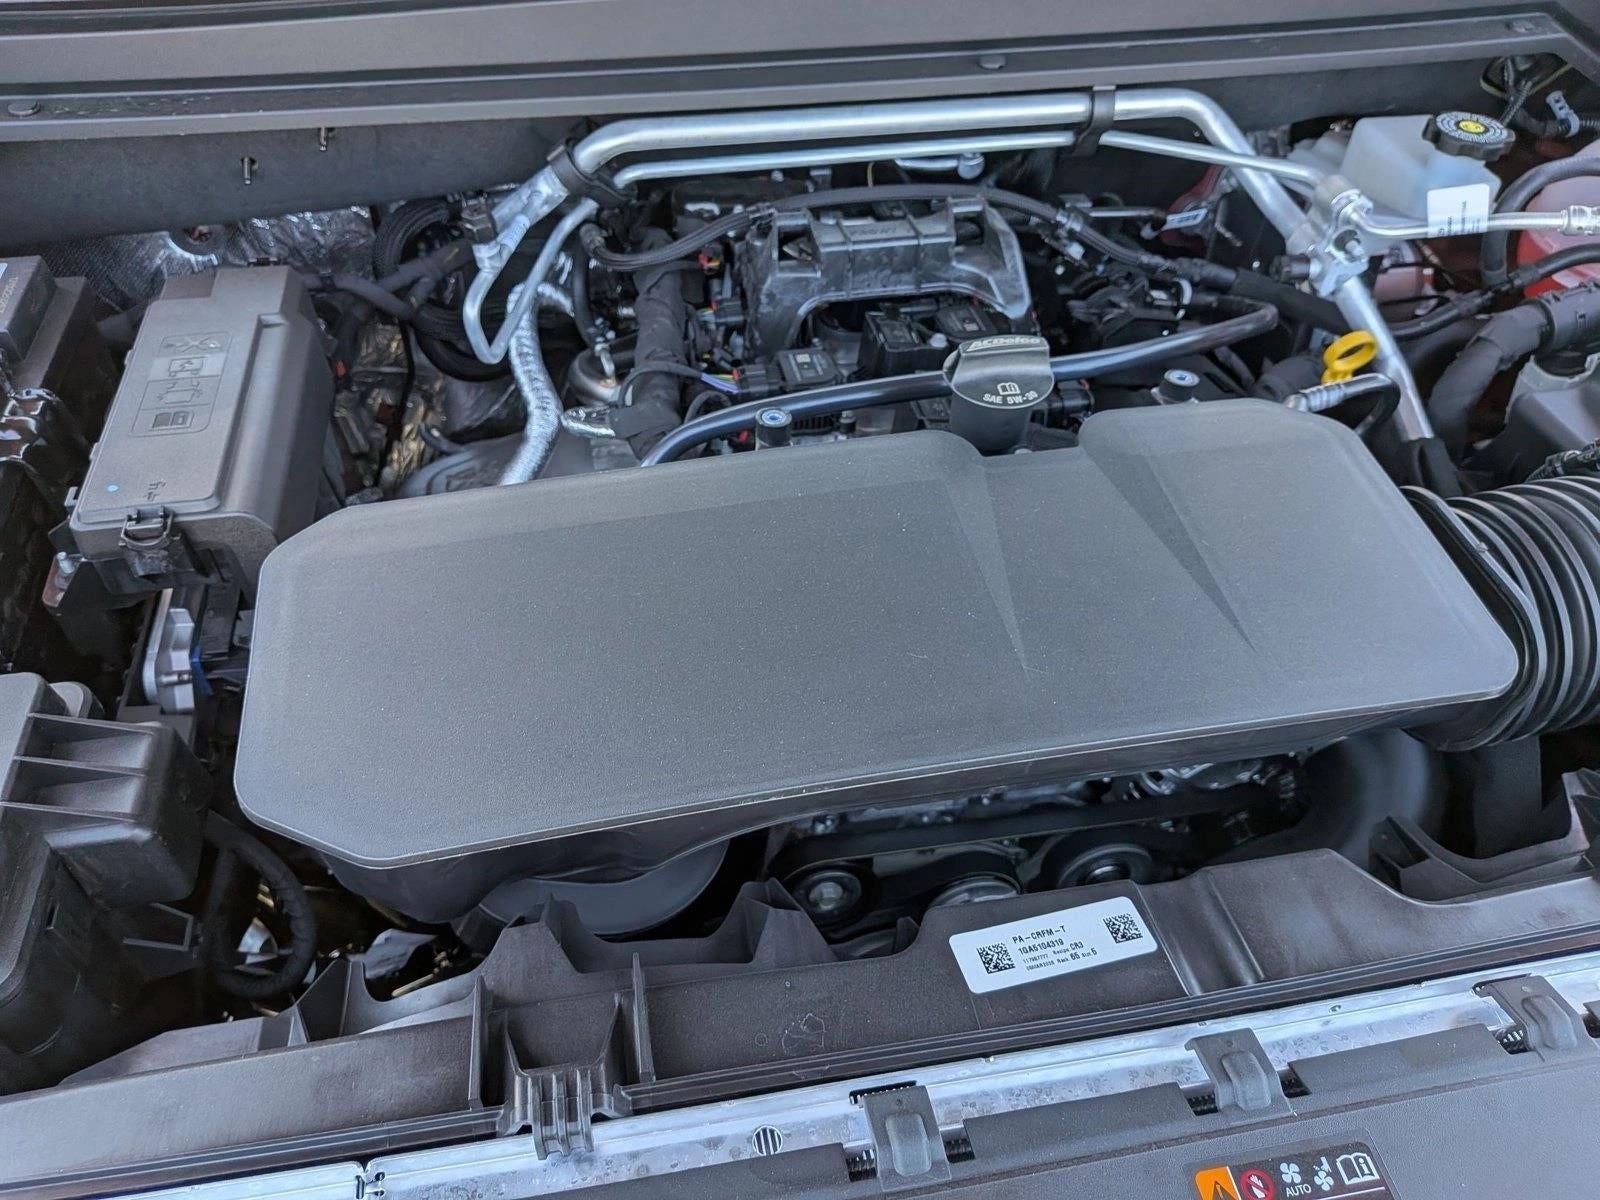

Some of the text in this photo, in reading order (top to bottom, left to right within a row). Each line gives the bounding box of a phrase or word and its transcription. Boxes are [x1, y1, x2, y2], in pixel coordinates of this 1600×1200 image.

[966, 337, 1040, 351] ACDelco
[983, 390, 1038, 404] SAE 5W-30
[1286, 1183, 1312, 1197] AUTO
